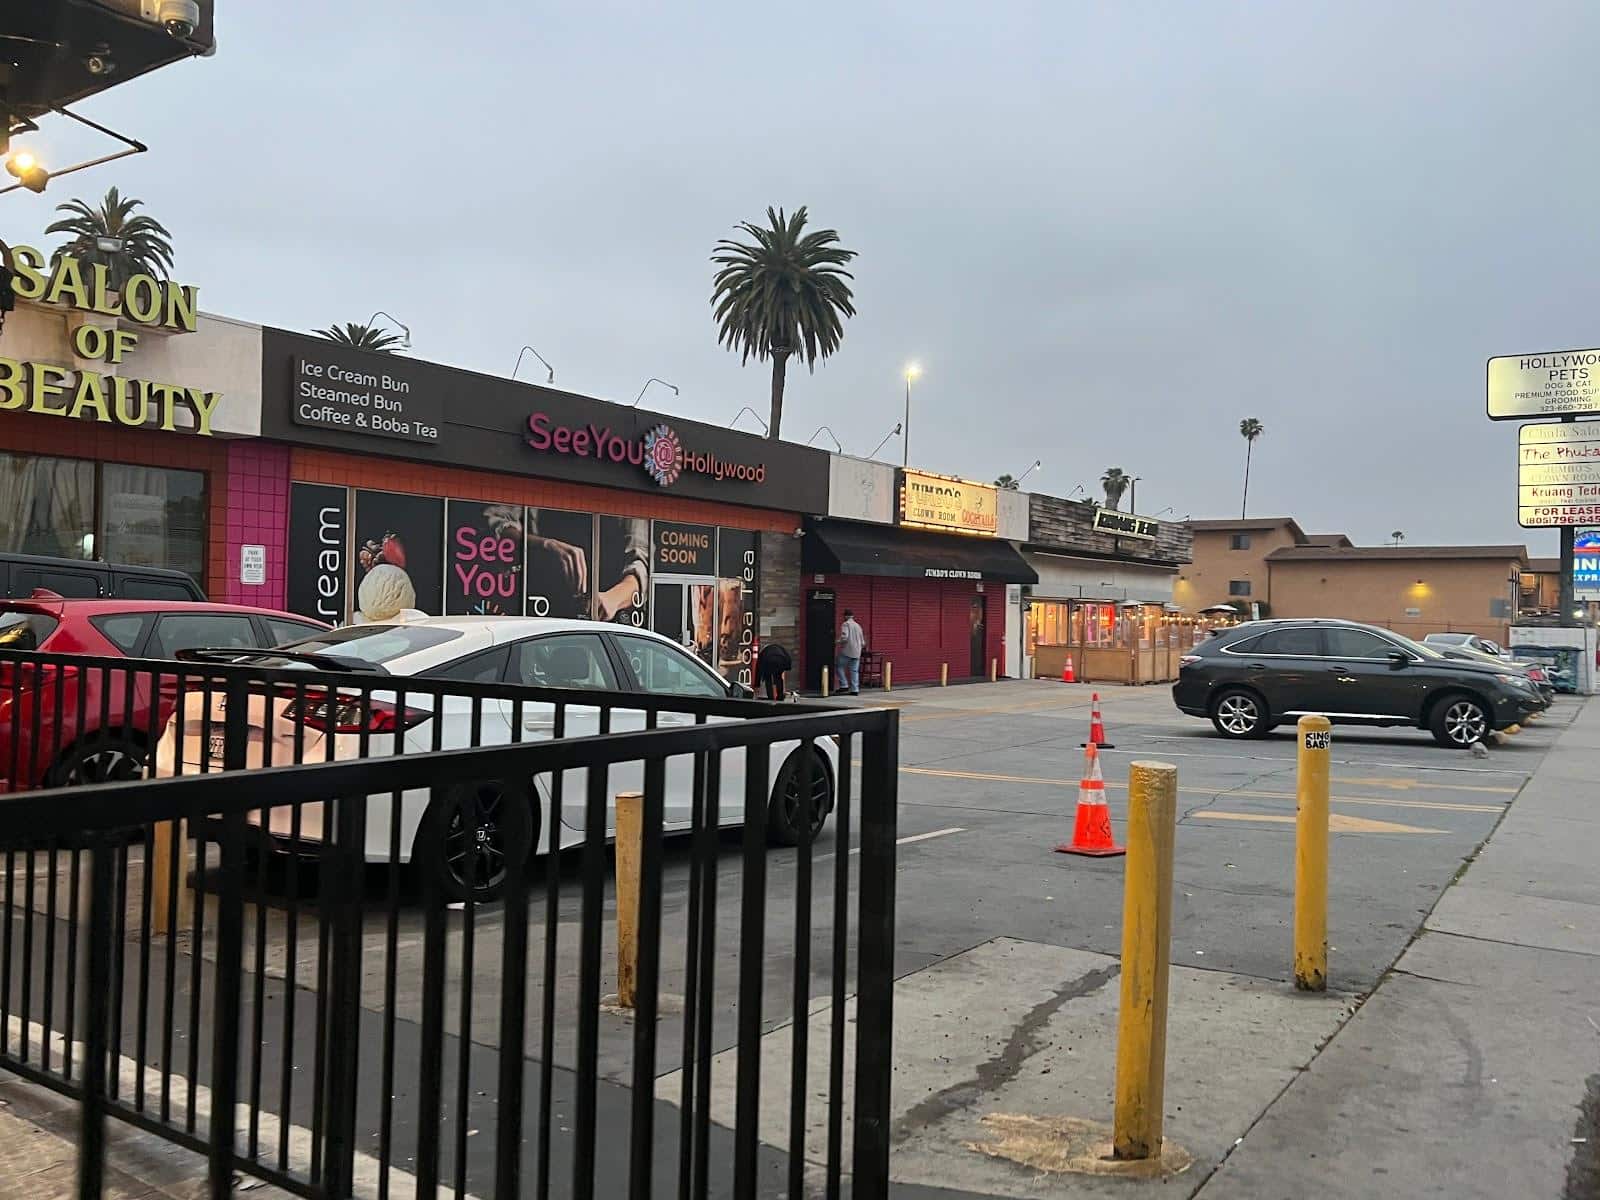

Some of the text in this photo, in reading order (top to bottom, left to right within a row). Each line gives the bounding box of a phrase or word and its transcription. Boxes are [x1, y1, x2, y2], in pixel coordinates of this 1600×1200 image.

[10, 245, 200, 332] SALON
[75, 324, 138, 363] OF
[1520, 354, 1600, 369] HOLLYWO
[300, 359, 409, 393] Ice Cream Bun
[1549, 368, 1589, 380] PETS
[1514, 391, 1552, 399] PREMIUM
[1555, 389, 1578, 397] FOOD
[1544, 382, 1563, 390] DOG
[0, 357, 224, 436] BEAUTY
[300, 382, 402, 412] Steamed Bun
[1544, 396, 1592, 405] GROOMING
[299, 403, 438, 438] Coffee & Boba Tea
[528, 411, 644, 465] SeeYou
[682, 449, 766, 483] Hollywood
[1523, 448, 1550, 460] The
[1532, 485, 1600, 498] Kruang Ted
[1535, 506, 1600, 516] FOR LEASE
[455, 526, 516, 562] See
[660, 530, 709, 549] COMING
[660, 548, 697, 565] SOON
[1574, 558, 1600, 571] IN
[317, 506, 340, 628] ream
[455, 563, 516, 598] You
[738, 550, 755, 686] Boba Tea
[1306, 732, 1330, 740] KING
[1306, 740, 1330, 749] BABY
